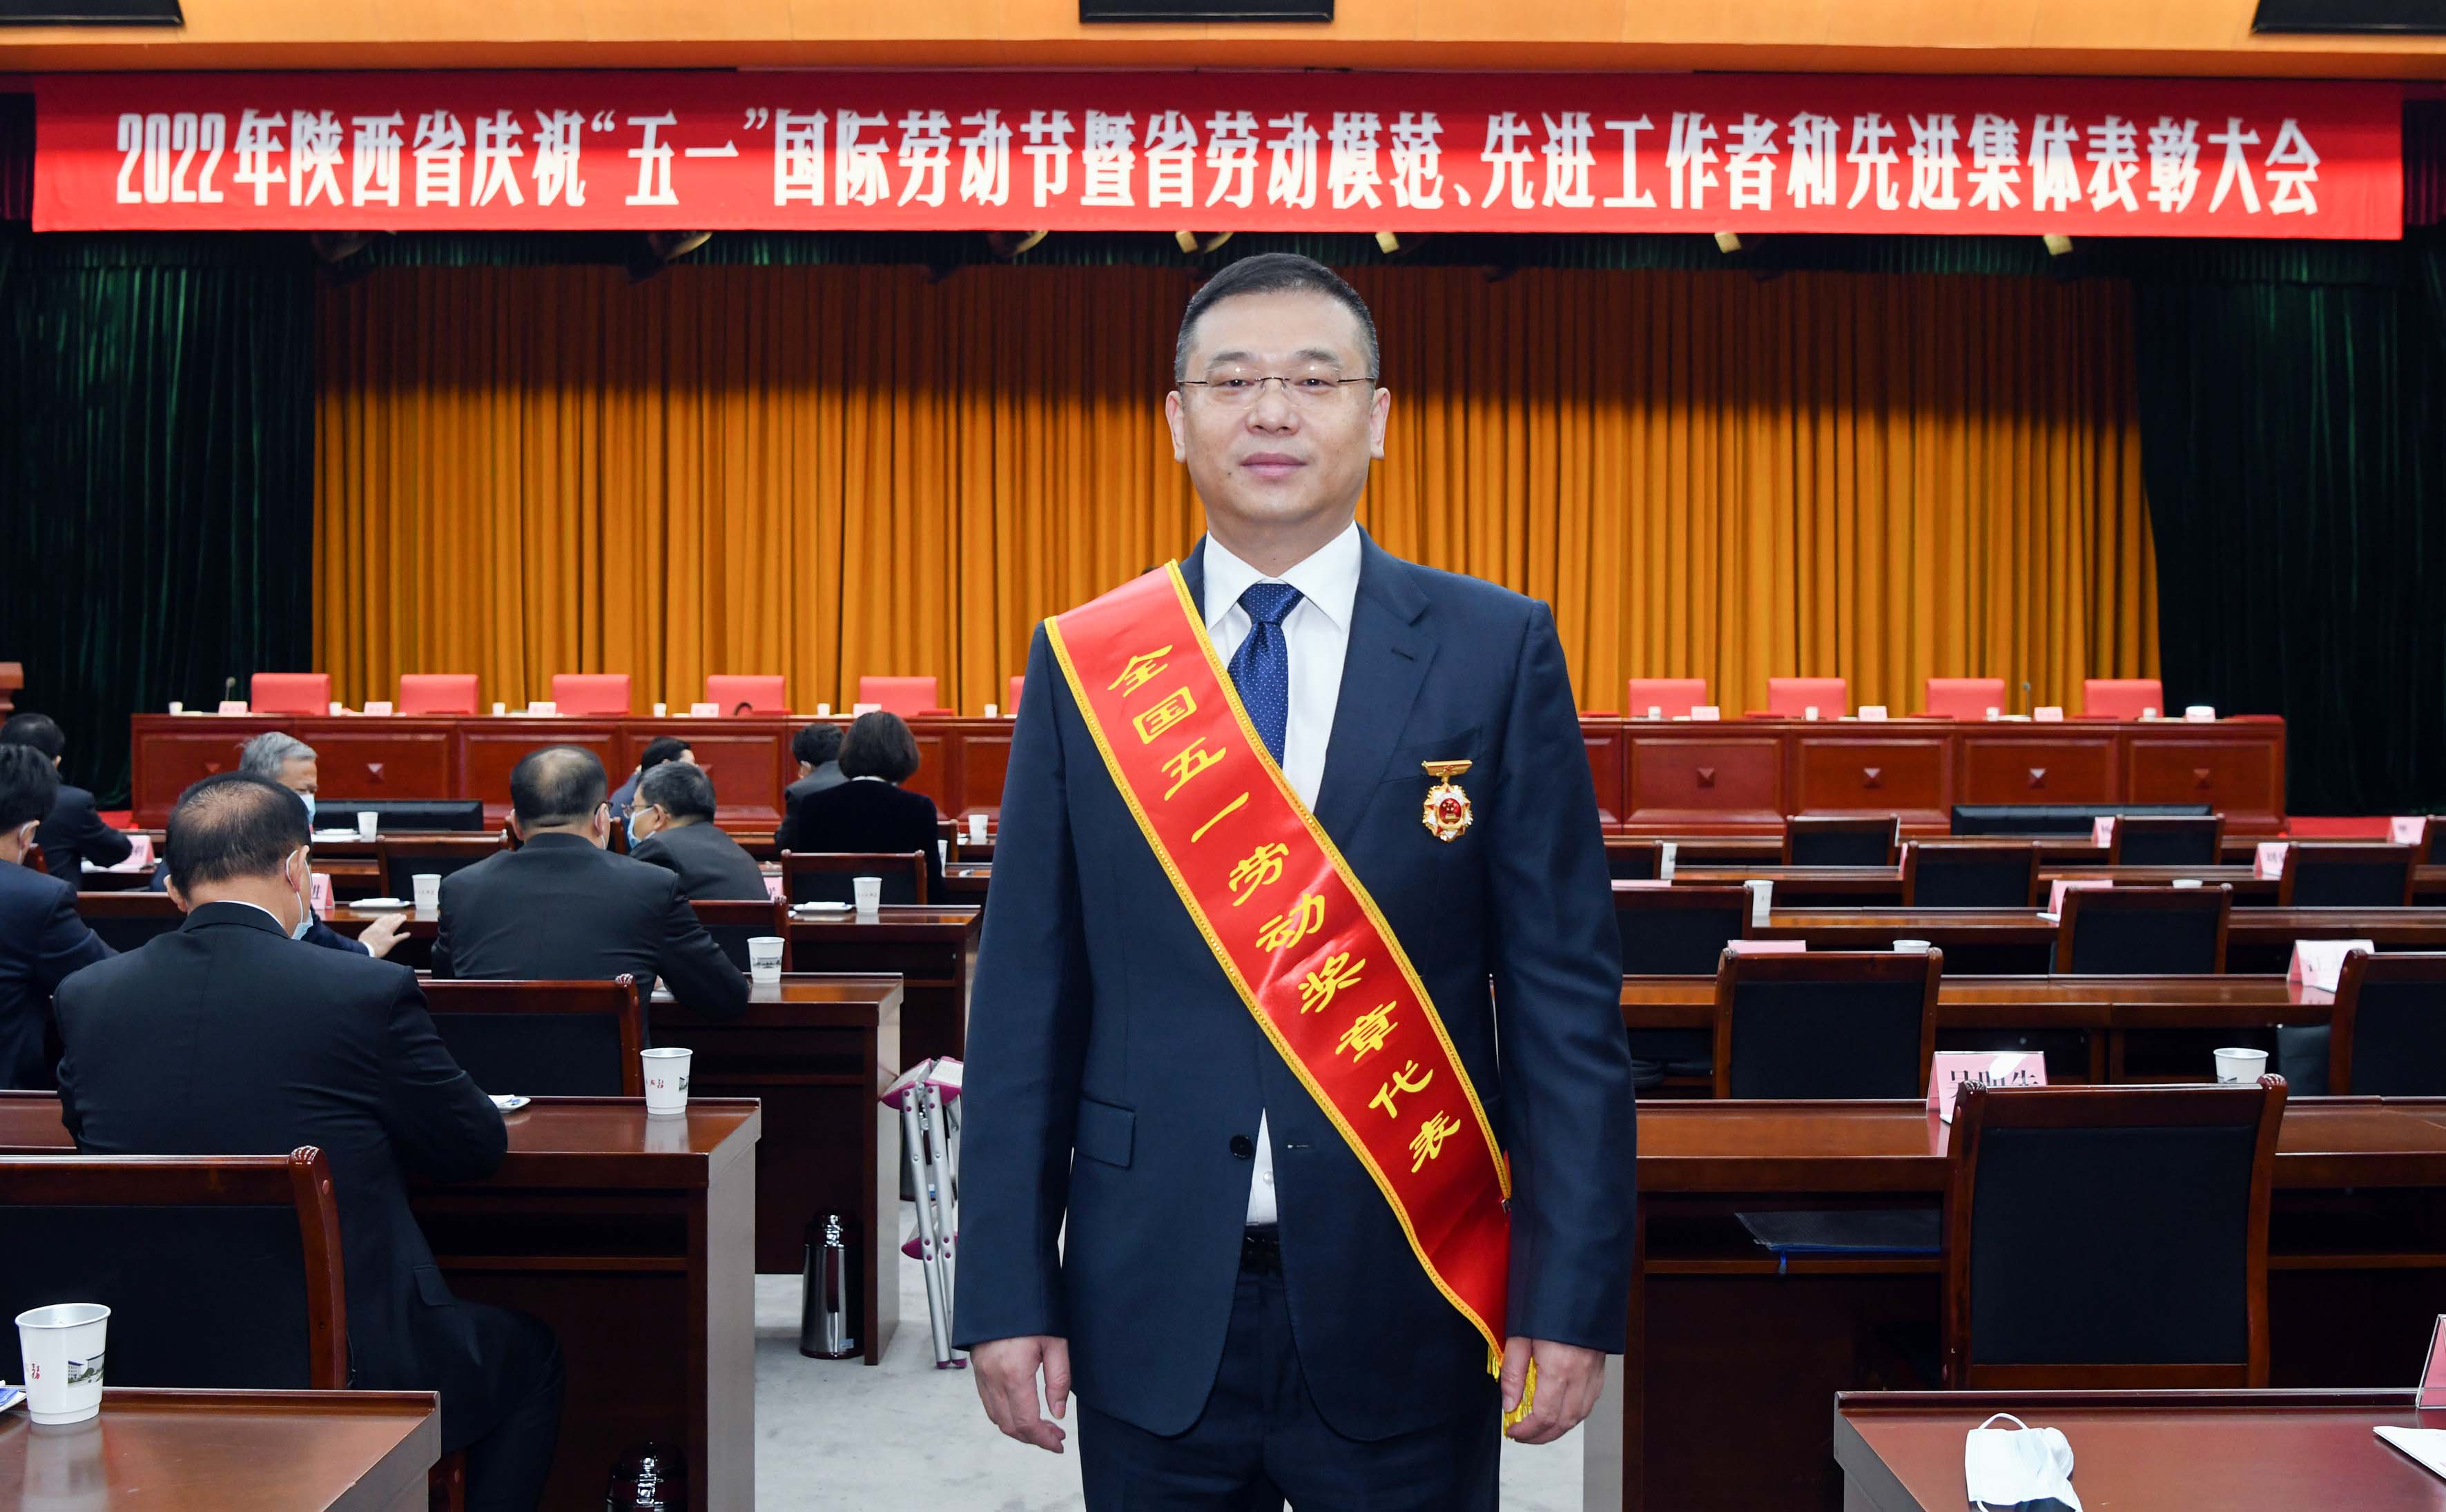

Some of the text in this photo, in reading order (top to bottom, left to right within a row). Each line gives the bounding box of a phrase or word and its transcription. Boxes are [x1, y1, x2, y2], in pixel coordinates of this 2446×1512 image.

[1107, 643, 1462, 1174] 全国五一劳动奖章代表
